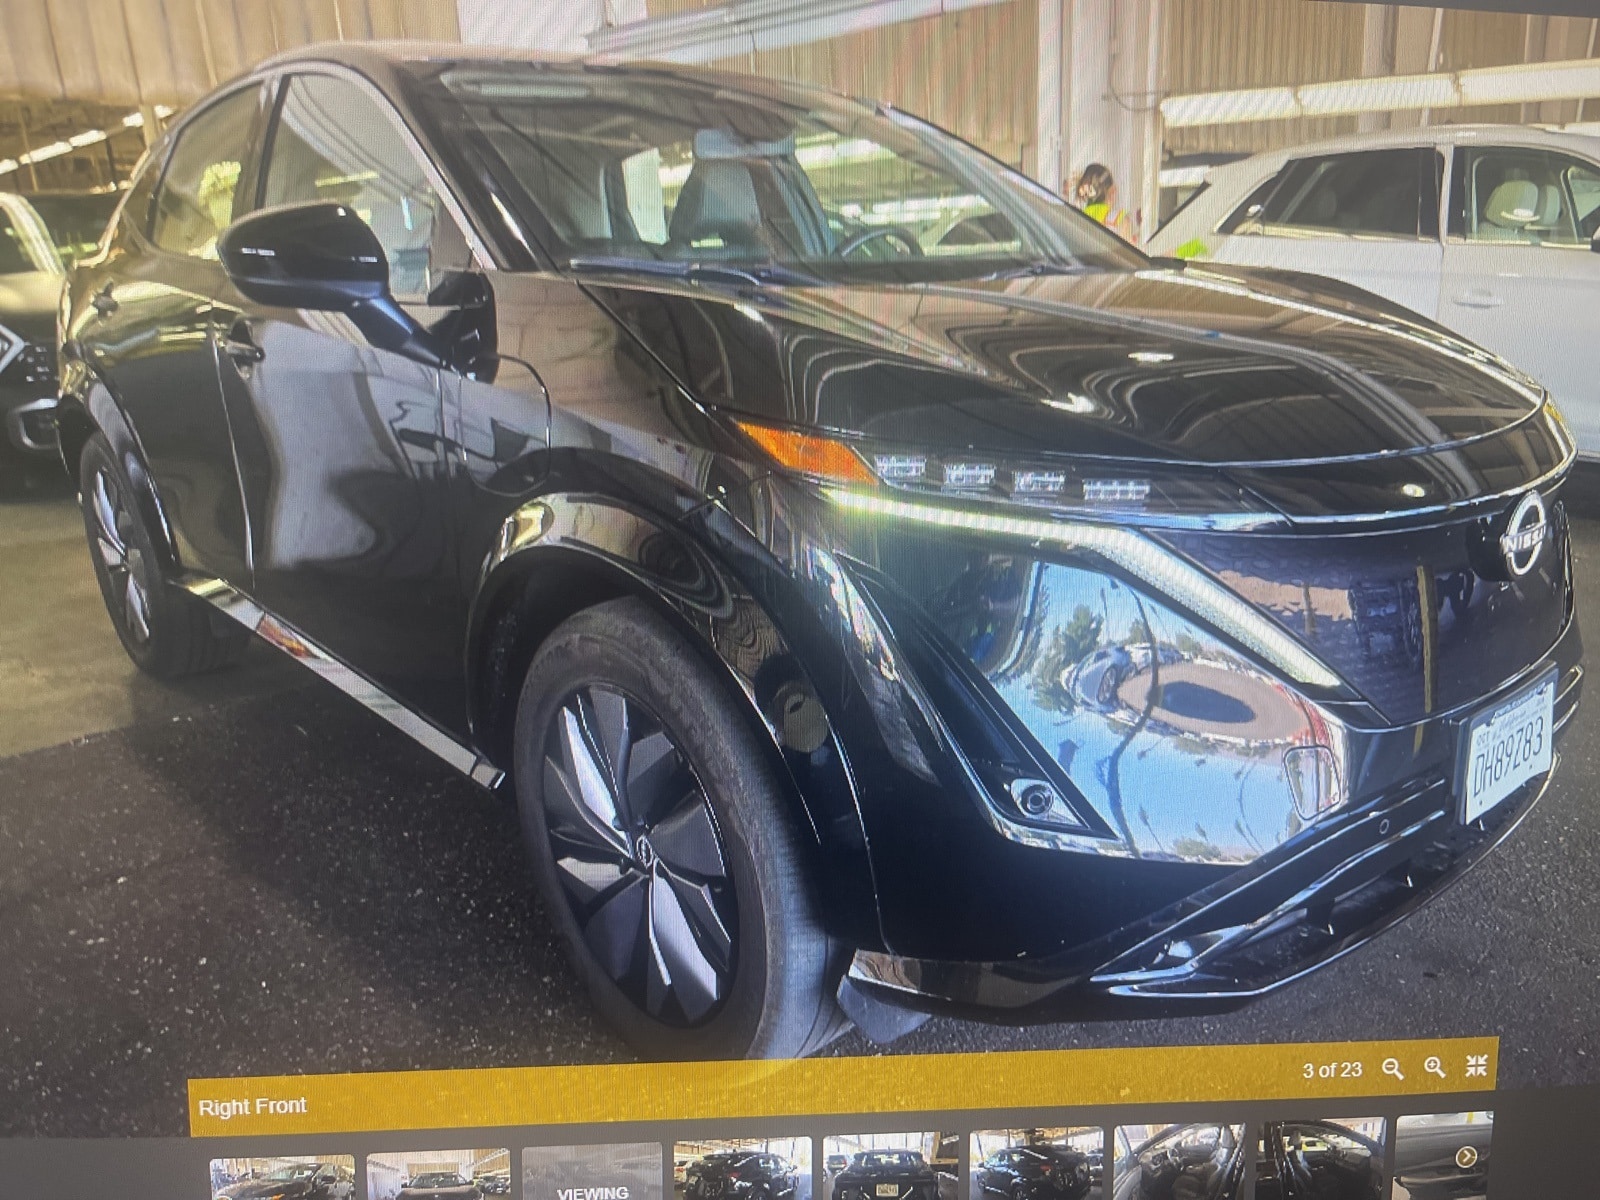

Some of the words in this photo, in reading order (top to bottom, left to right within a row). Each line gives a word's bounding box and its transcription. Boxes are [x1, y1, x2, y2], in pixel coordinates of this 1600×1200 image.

[1303, 1063, 1314, 1078] 3
[1319, 1062, 1337, 1078] of
[1341, 1061, 1363, 1078] 23
[199, 1098, 251, 1120] Right
[256, 1097, 308, 1114] Front
[557, 1186, 629, 1200] VIEWING
